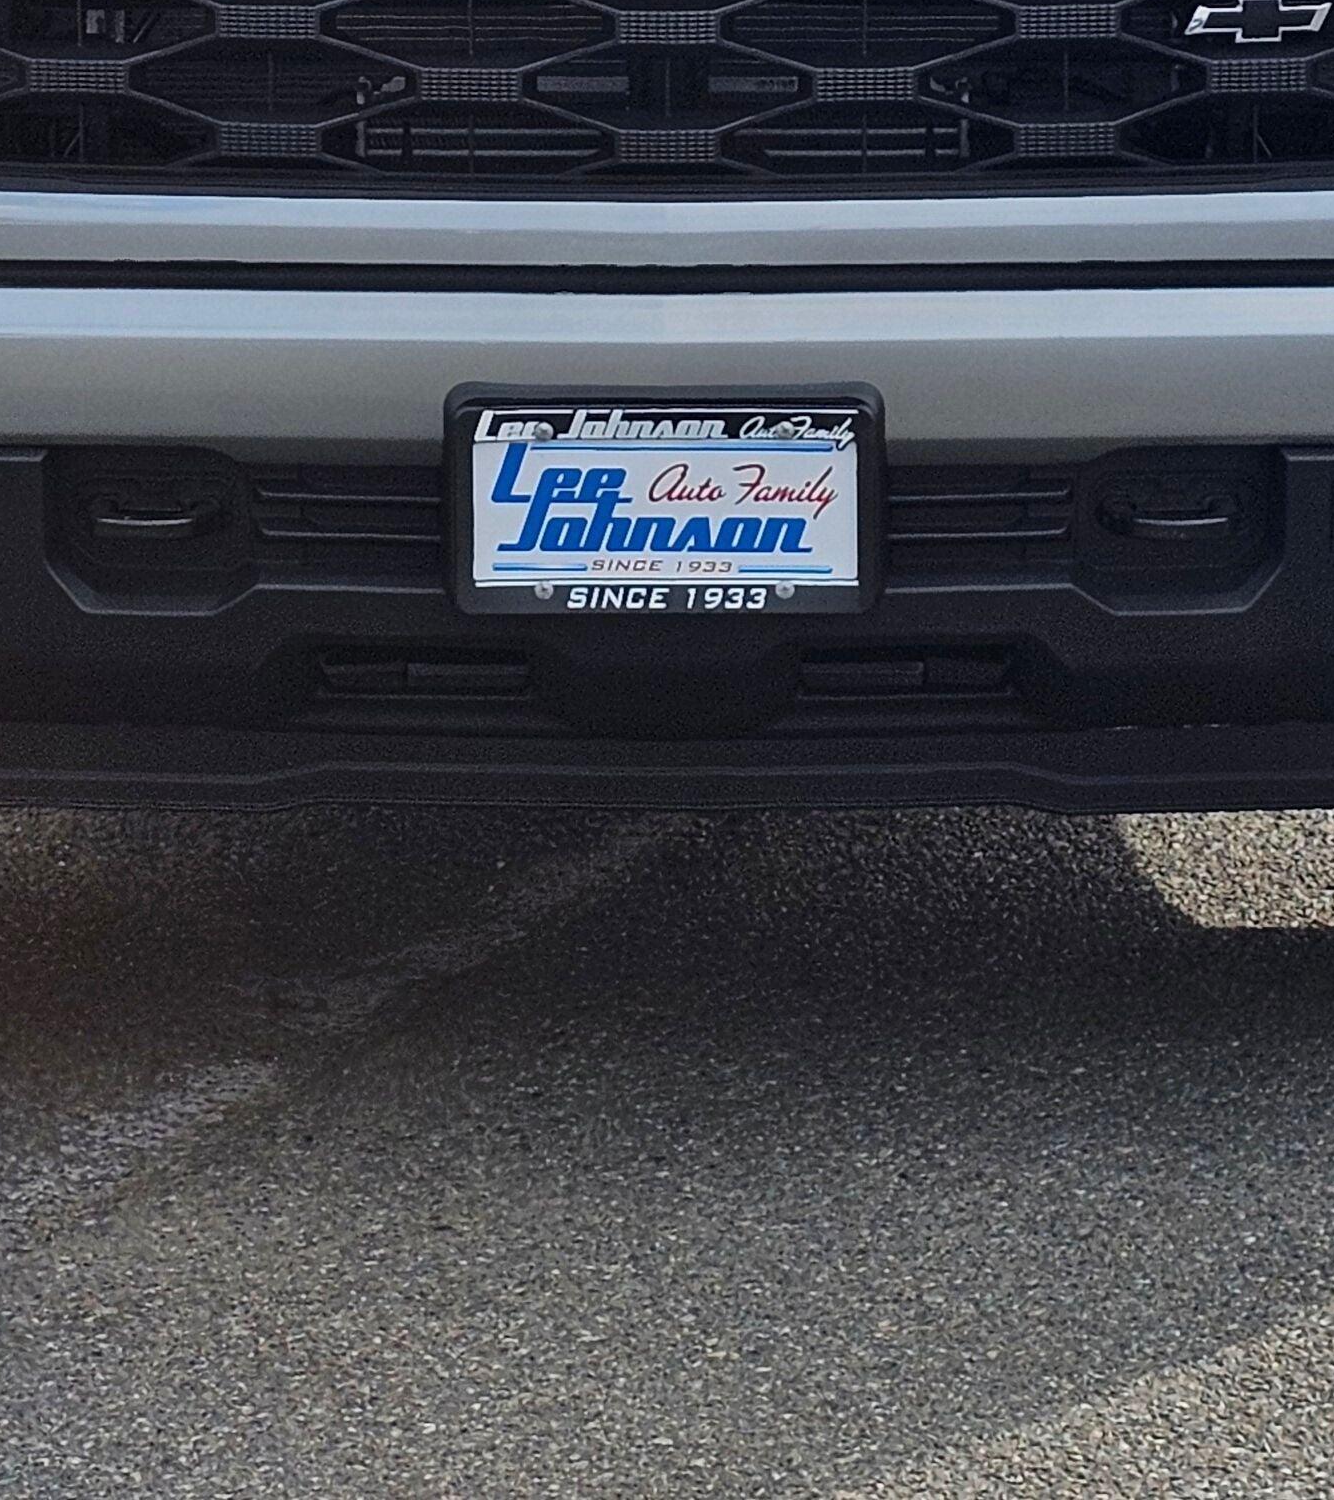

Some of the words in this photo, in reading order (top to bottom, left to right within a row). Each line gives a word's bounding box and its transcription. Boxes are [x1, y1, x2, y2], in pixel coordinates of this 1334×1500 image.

[557, 408, 728, 440] Johnson
[739, 415, 793, 440] Aut
[790, 415, 855, 449] Family
[492, 443, 633, 504] Lee
[648, 463, 726, 503] Auto
[732, 463, 838, 520] Family
[497, 498, 813, 553] Johnson
[591, 559, 663, 572] SINCE
[676, 560, 733, 573] 1933
[566, 586, 670, 610] SINCE
[686, 587, 768, 610] 1933
